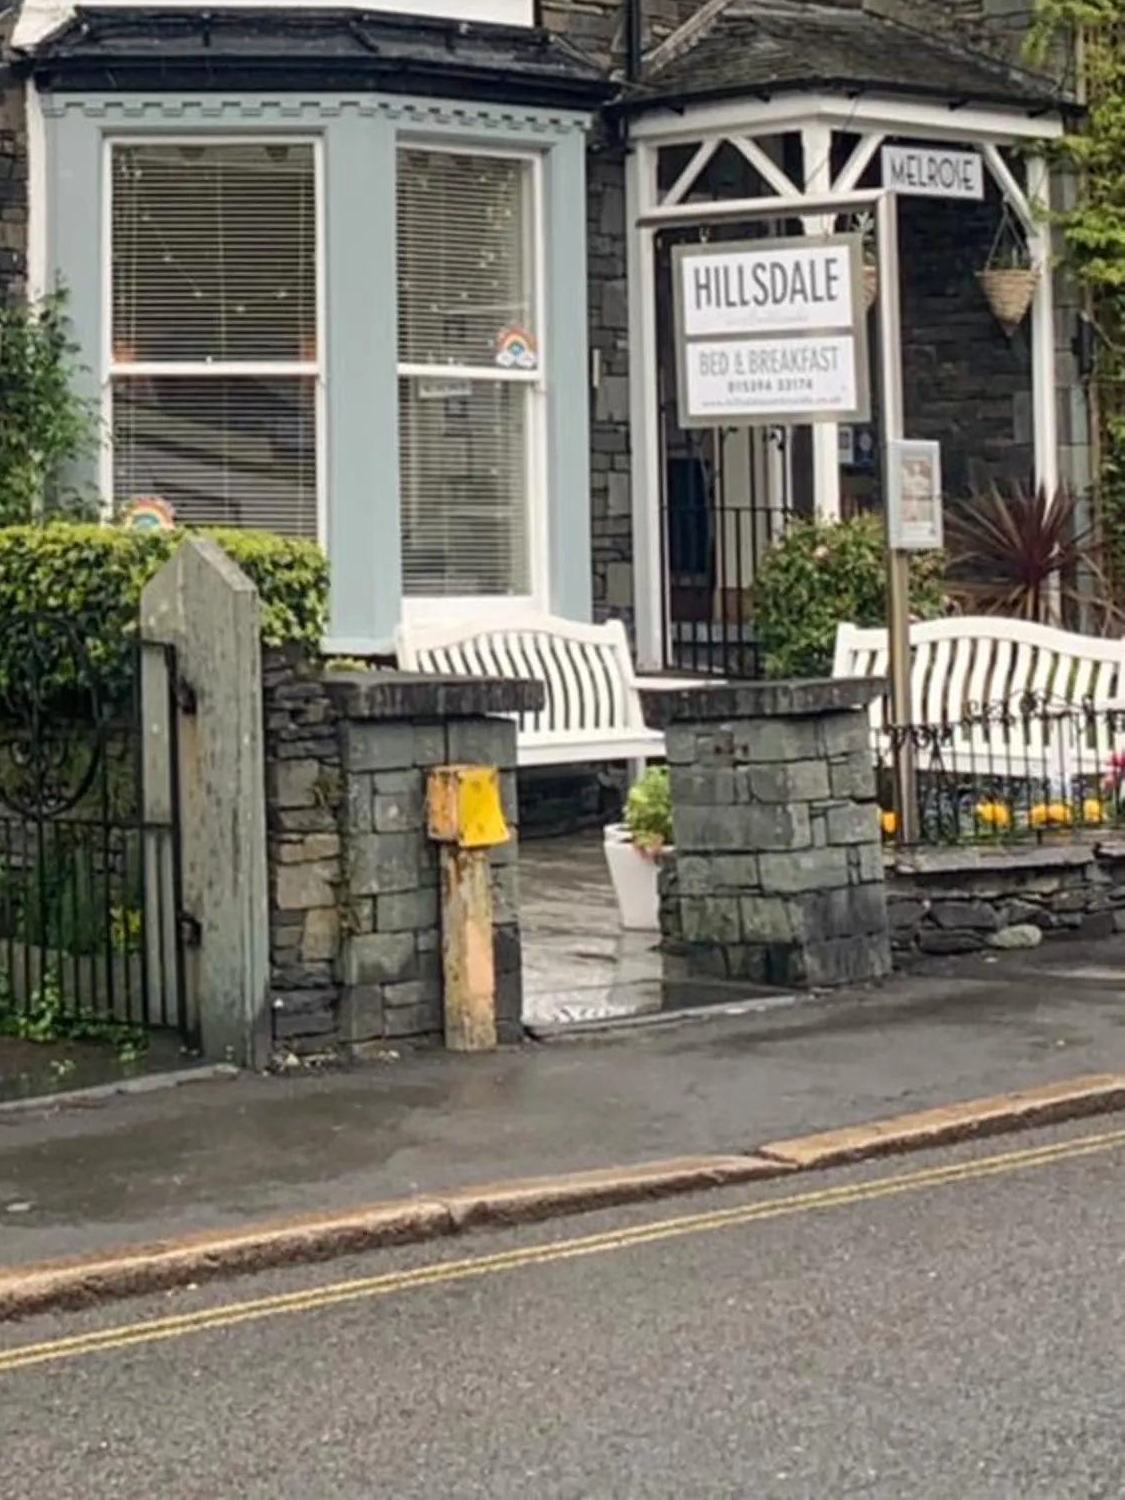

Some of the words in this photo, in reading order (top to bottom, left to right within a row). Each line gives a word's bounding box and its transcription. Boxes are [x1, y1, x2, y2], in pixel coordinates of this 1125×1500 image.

[693, 257, 839, 311] HILLSDALE
[699, 351, 729, 377] BED
[734, 350, 747, 375] &
[748, 345, 839, 375] BREAKFAST
